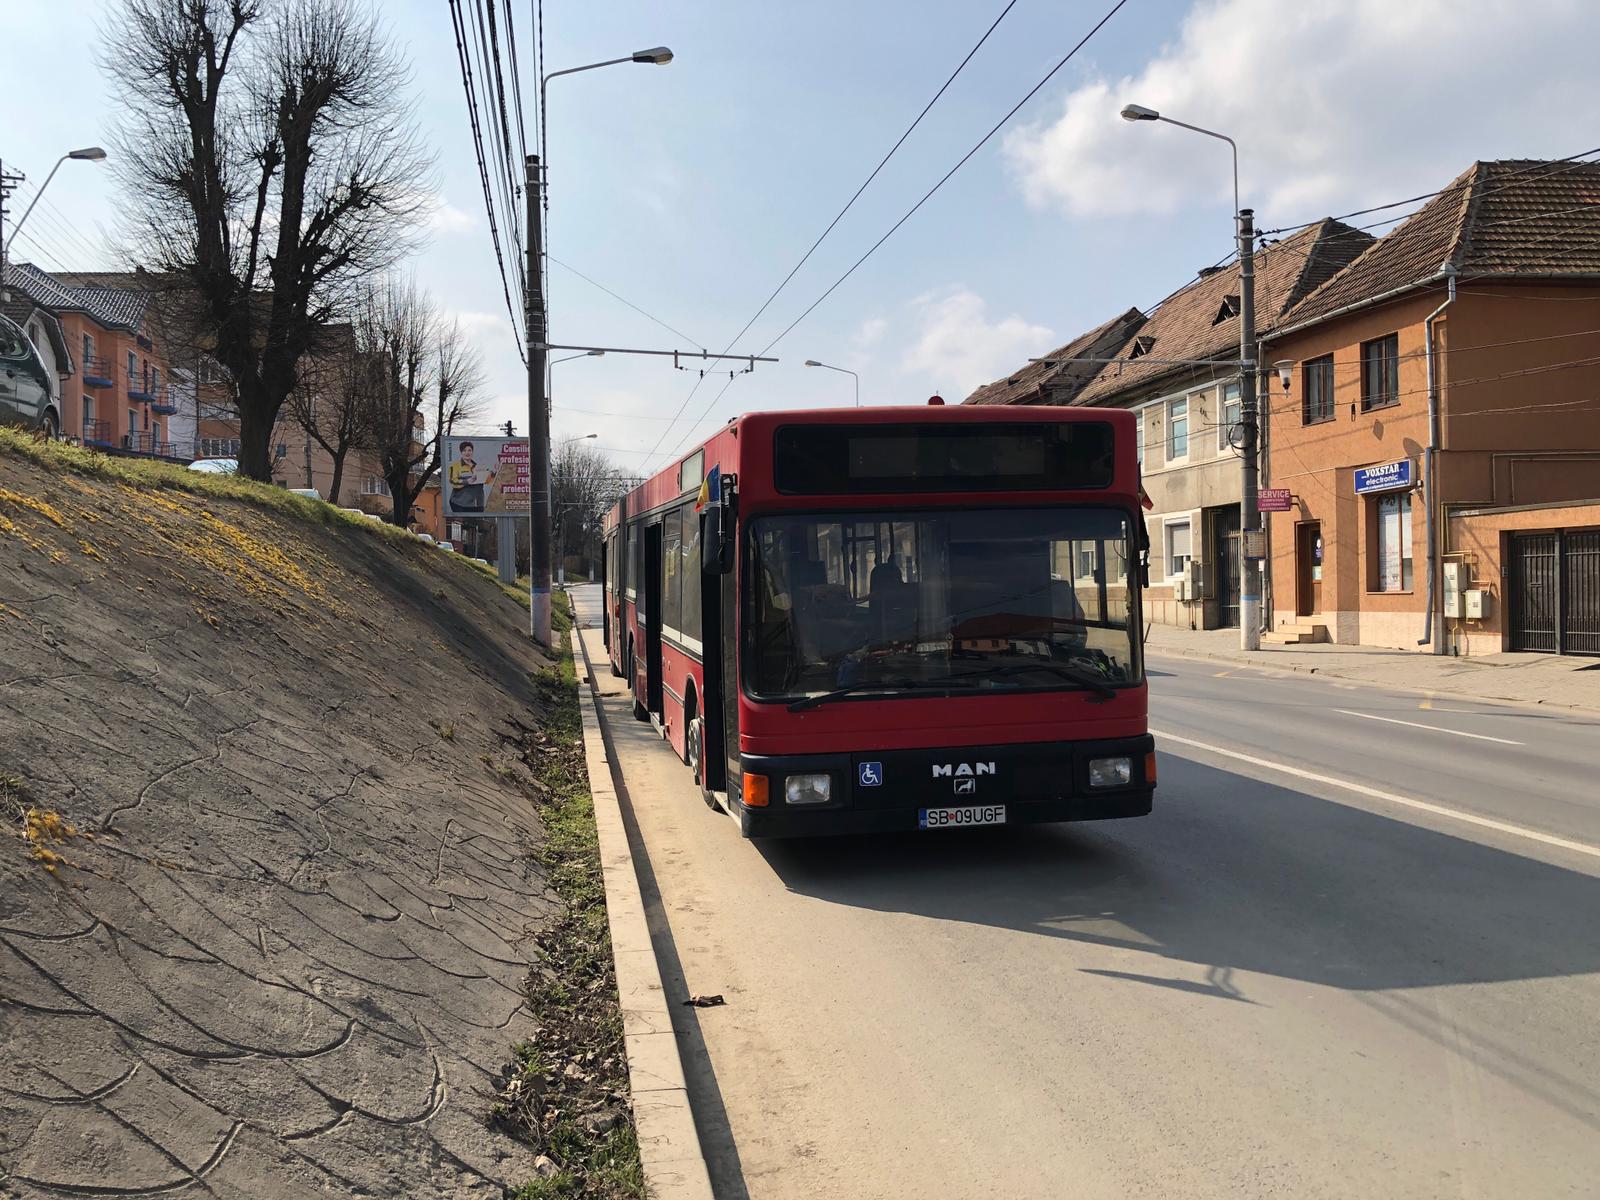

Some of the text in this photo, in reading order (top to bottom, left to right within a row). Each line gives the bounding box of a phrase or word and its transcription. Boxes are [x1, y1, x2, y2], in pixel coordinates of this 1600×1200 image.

[1365, 464, 1399, 478] VOXSTAR
[1366, 474, 1398, 485] electronic
[503, 485, 530, 494] proiect
[1258, 490, 1289, 498] SERVICE
[932, 761, 995, 778] MAN
